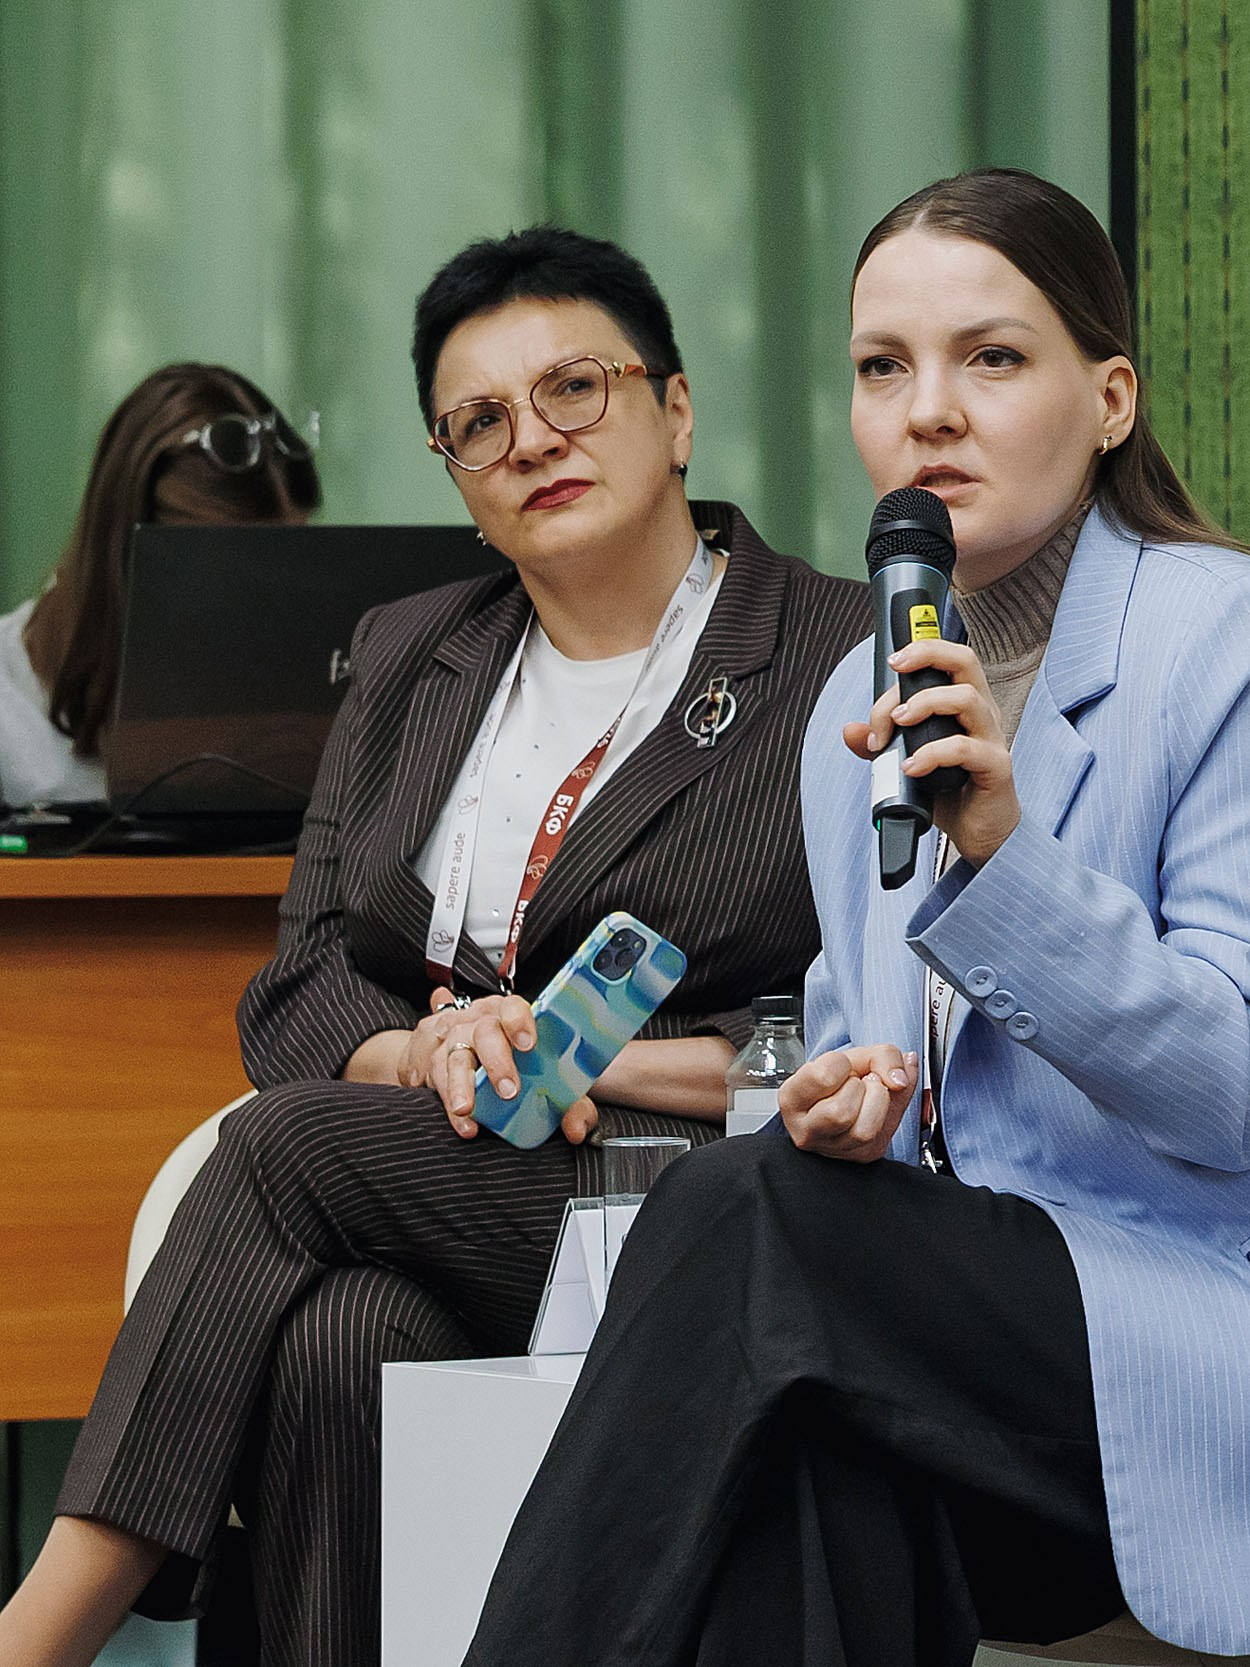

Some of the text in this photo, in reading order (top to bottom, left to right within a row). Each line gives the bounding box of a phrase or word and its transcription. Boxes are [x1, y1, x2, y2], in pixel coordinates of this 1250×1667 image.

[545, 793, 574, 836] БКФ
[446, 832, 466, 910] sapere aude
